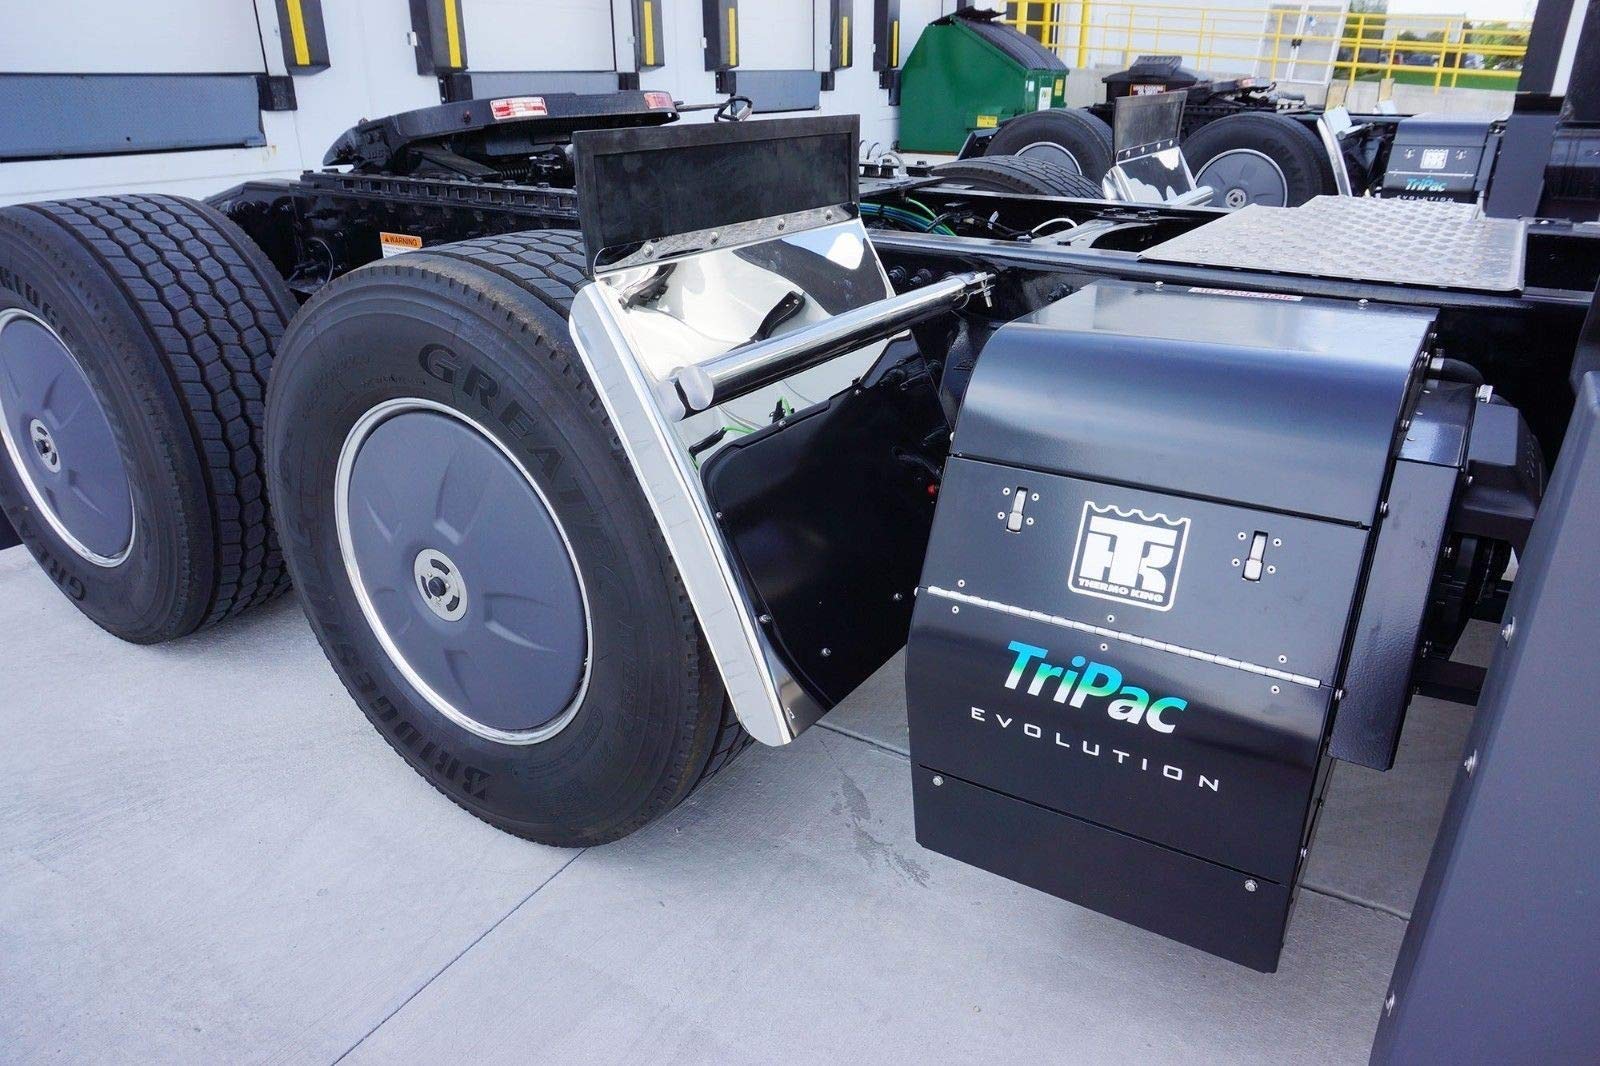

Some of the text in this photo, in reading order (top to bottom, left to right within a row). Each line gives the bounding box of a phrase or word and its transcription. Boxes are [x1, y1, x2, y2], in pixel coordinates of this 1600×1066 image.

[390, 236, 418, 247] WARNING
[1078, 578, 1164, 603] THERMO KING
[1004, 640, 1188, 734] TriPac
[971, 706, 1219, 792] EVOLUTION
